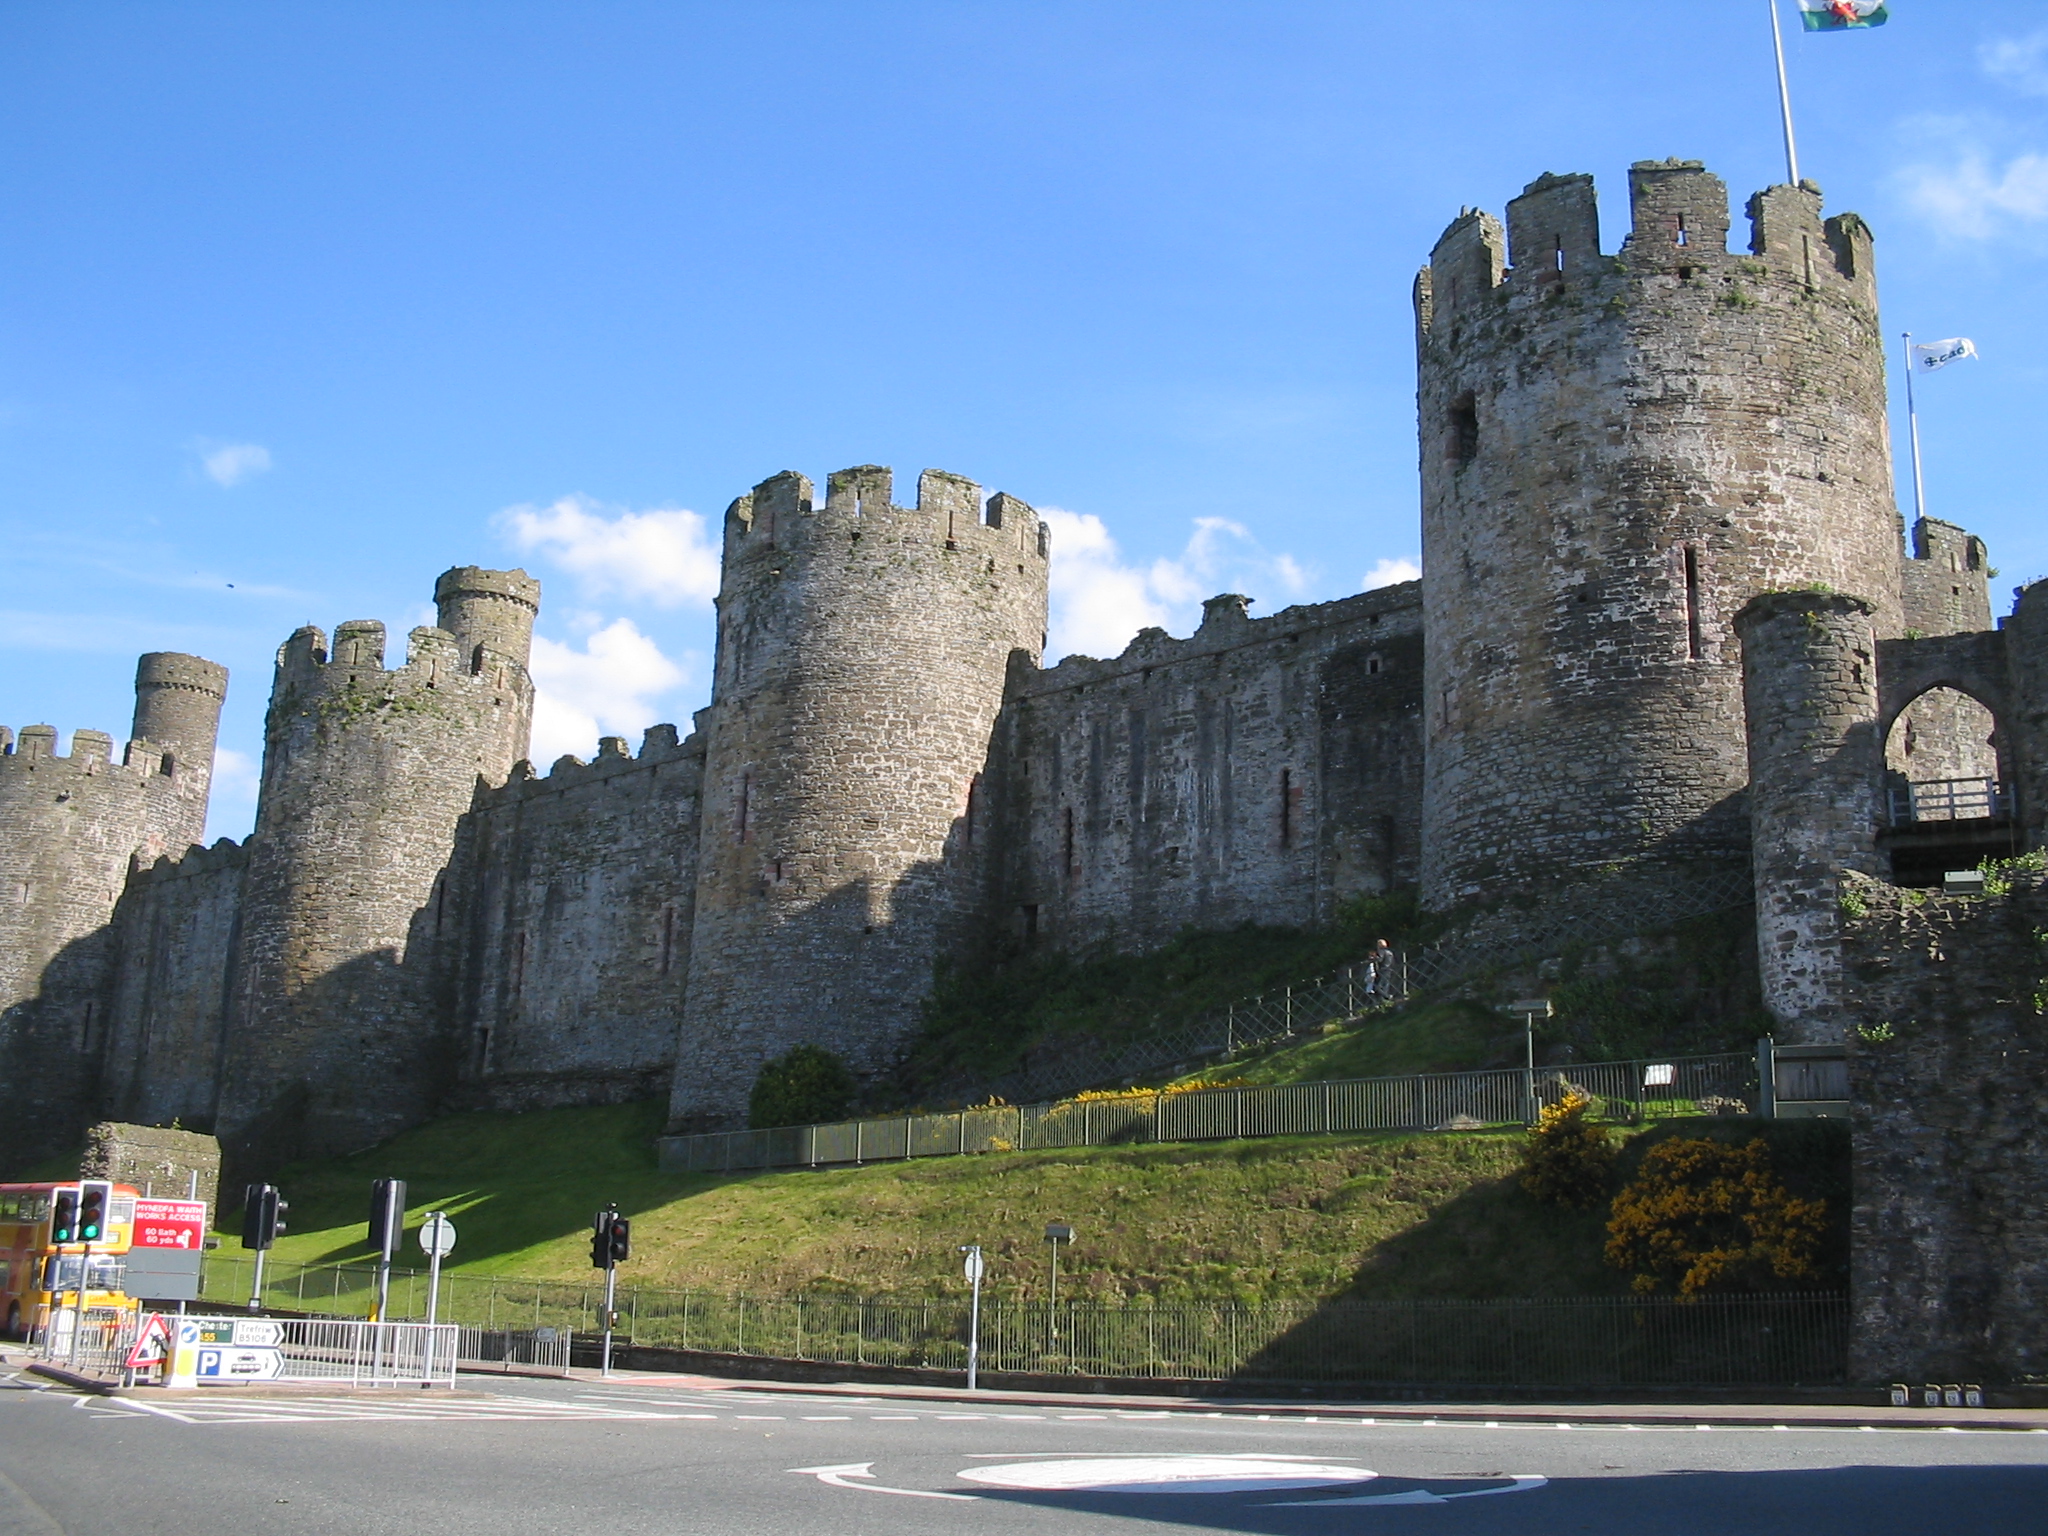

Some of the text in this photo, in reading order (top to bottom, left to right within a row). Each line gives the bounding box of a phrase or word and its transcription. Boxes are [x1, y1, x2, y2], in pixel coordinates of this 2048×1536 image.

[136, 1212, 202, 1222] WORKS ACCESS
[145, 1227, 157, 1236] 60
[159, 1237, 174, 1245] yds
[199, 1321, 232, 1331] Chester
[241, 1324, 272, 1333] Trefriw
[239, 1333, 267, 1343] B5106
[201, 1352, 218, 1374] P
